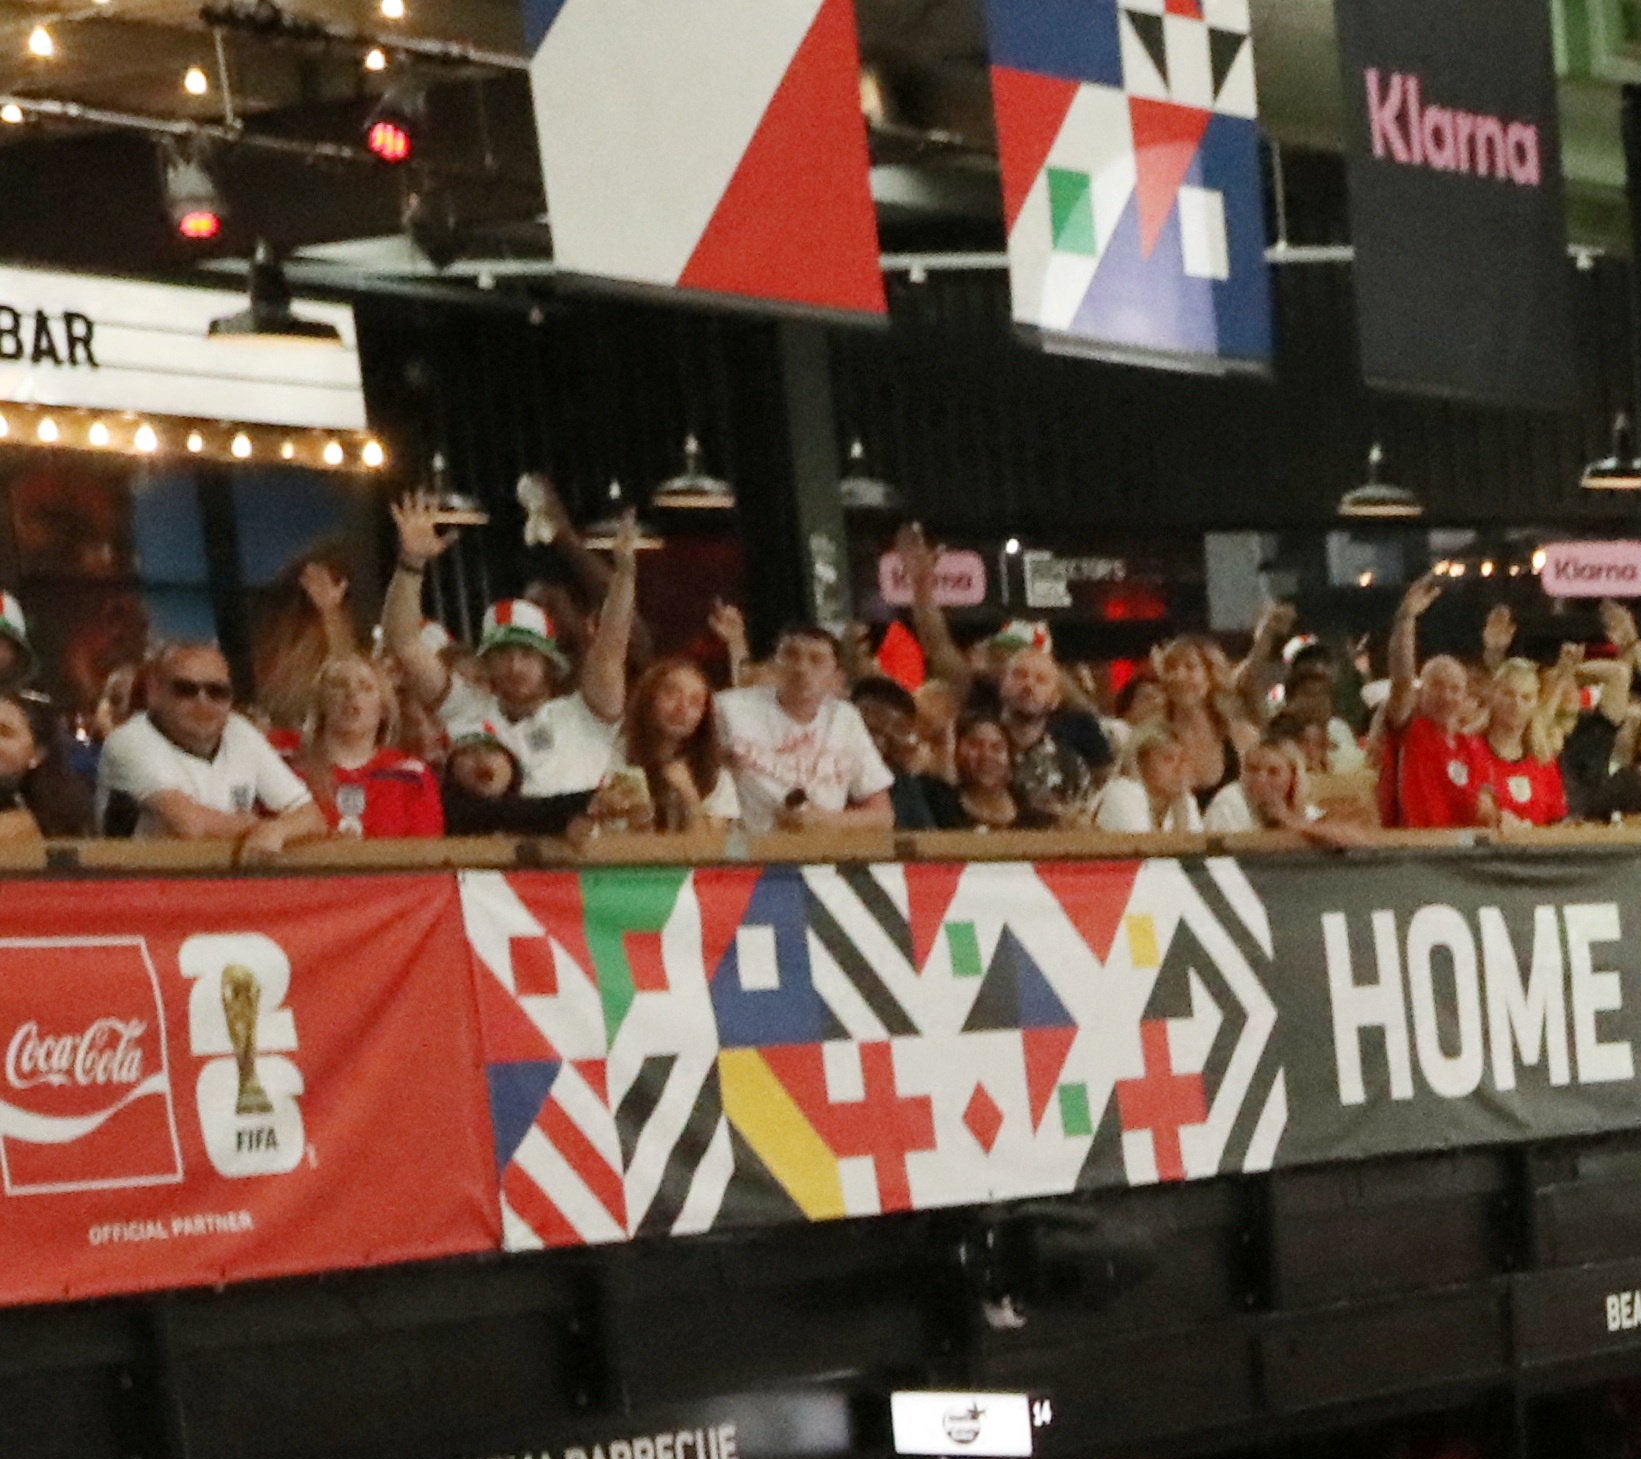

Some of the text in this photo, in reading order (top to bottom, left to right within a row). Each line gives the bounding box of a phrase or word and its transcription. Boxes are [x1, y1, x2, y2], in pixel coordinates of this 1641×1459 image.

[1364, 66, 1541, 187] Klarna
[0, 305, 98, 367] BAR
[1553, 558, 1637, 582] Klarna
[1321, 902, 1635, 1106] HOME
[236, 1127, 279, 1153] FIFA
[88, 1209, 255, 1246] OFFICIAL PARTNER
